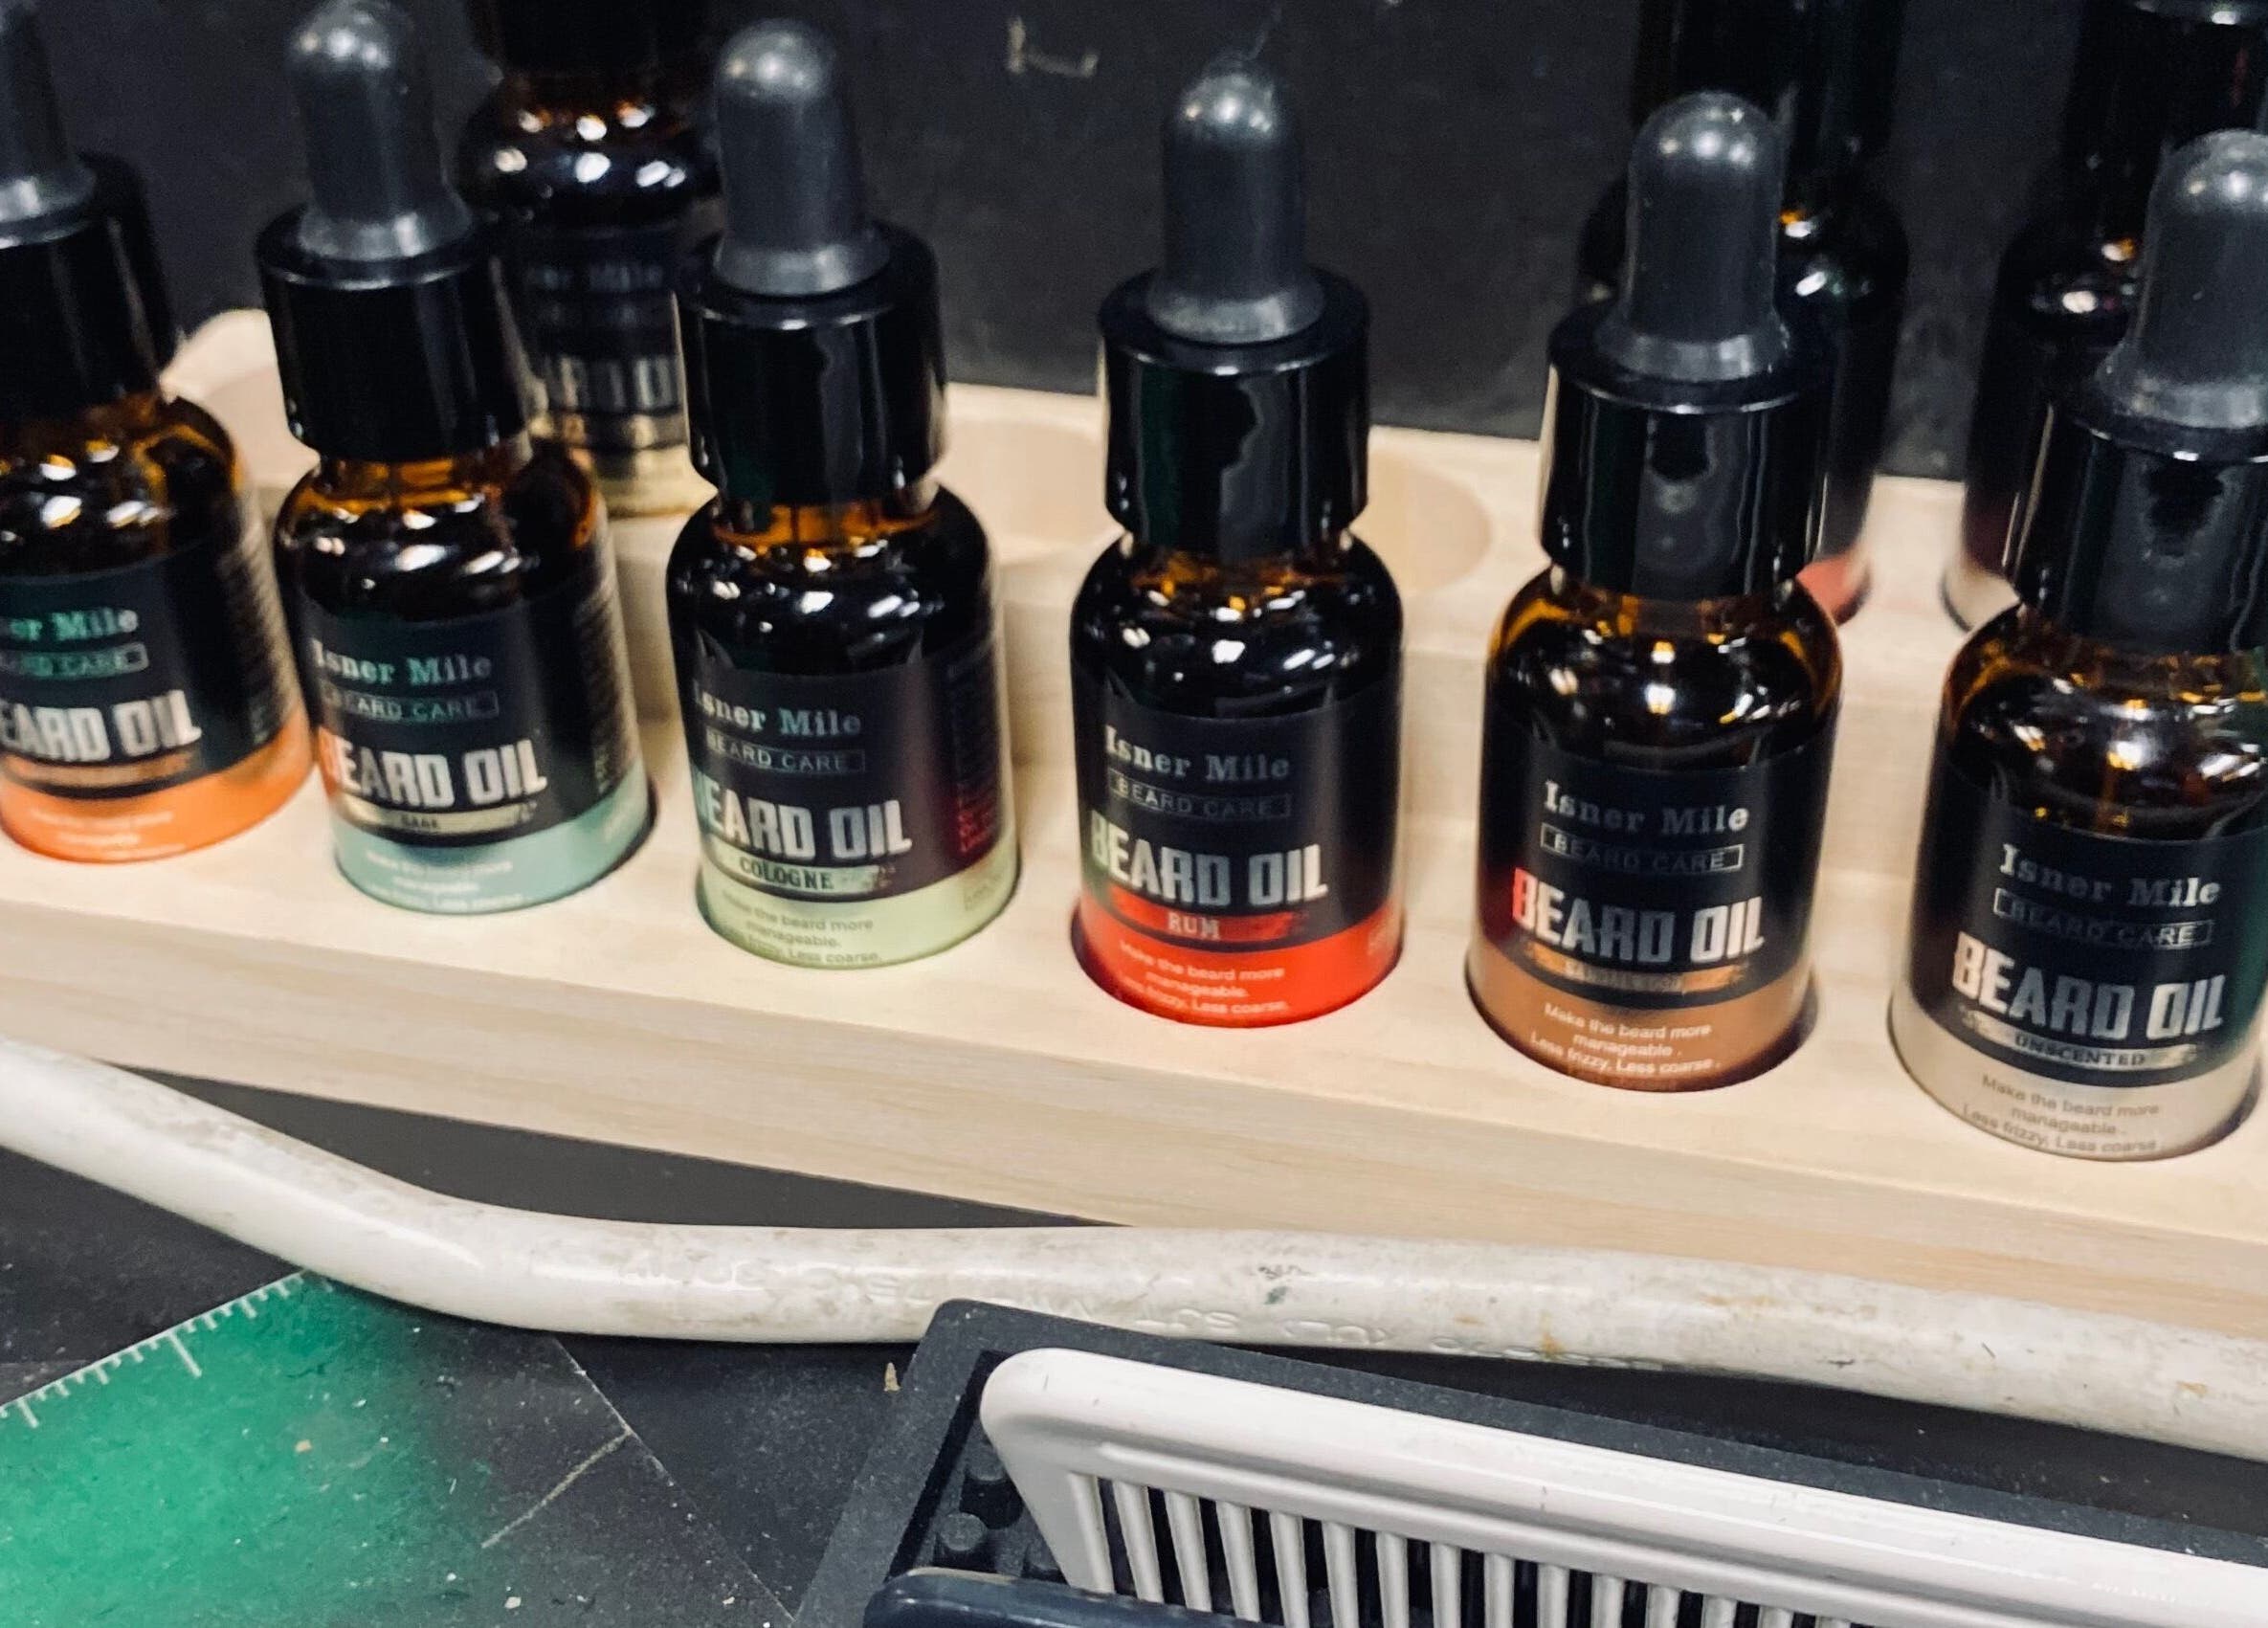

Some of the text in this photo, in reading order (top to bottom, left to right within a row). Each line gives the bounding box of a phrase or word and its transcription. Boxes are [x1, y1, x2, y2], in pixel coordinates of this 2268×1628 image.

[52, 607, 138, 640] Mile
[310, 637, 492, 686] Isner Mile
[0, 689, 202, 762] EARD OIL
[778, 706, 861, 737] Mile
[464, 739, 547, 805] OIL
[781, 749, 849, 771] CARE
[1104, 723, 1290, 783] Isner Mile
[1115, 775, 1192, 814] BEARD
[1544, 779, 1749, 835] Isner Mile
[830, 800, 912, 859] OIL
[1091, 809, 1232, 907] BEARD
[1248, 843, 1328, 906] OIL
[1554, 832, 1641, 869] BEARD
[740, 857, 834, 889] COLOGNE
[1999, 843, 2222, 907] Isner Mile
[831, 919, 874, 932] more
[1167, 911, 1220, 941] RUM
[1512, 867, 1766, 964] BEARD OIL
[2117, 924, 2199, 948] CARE
[1952, 930, 2226, 1040] BEARD OIL
[1544, 1002, 1713, 1039] Make the beard more
[1616, 1059, 1657, 1075] Less
[2014, 1033, 2146, 1067] UNSCENTED
[1982, 1073, 2160, 1117] Make the beard more
[2057, 1136, 2098, 1152] Less
